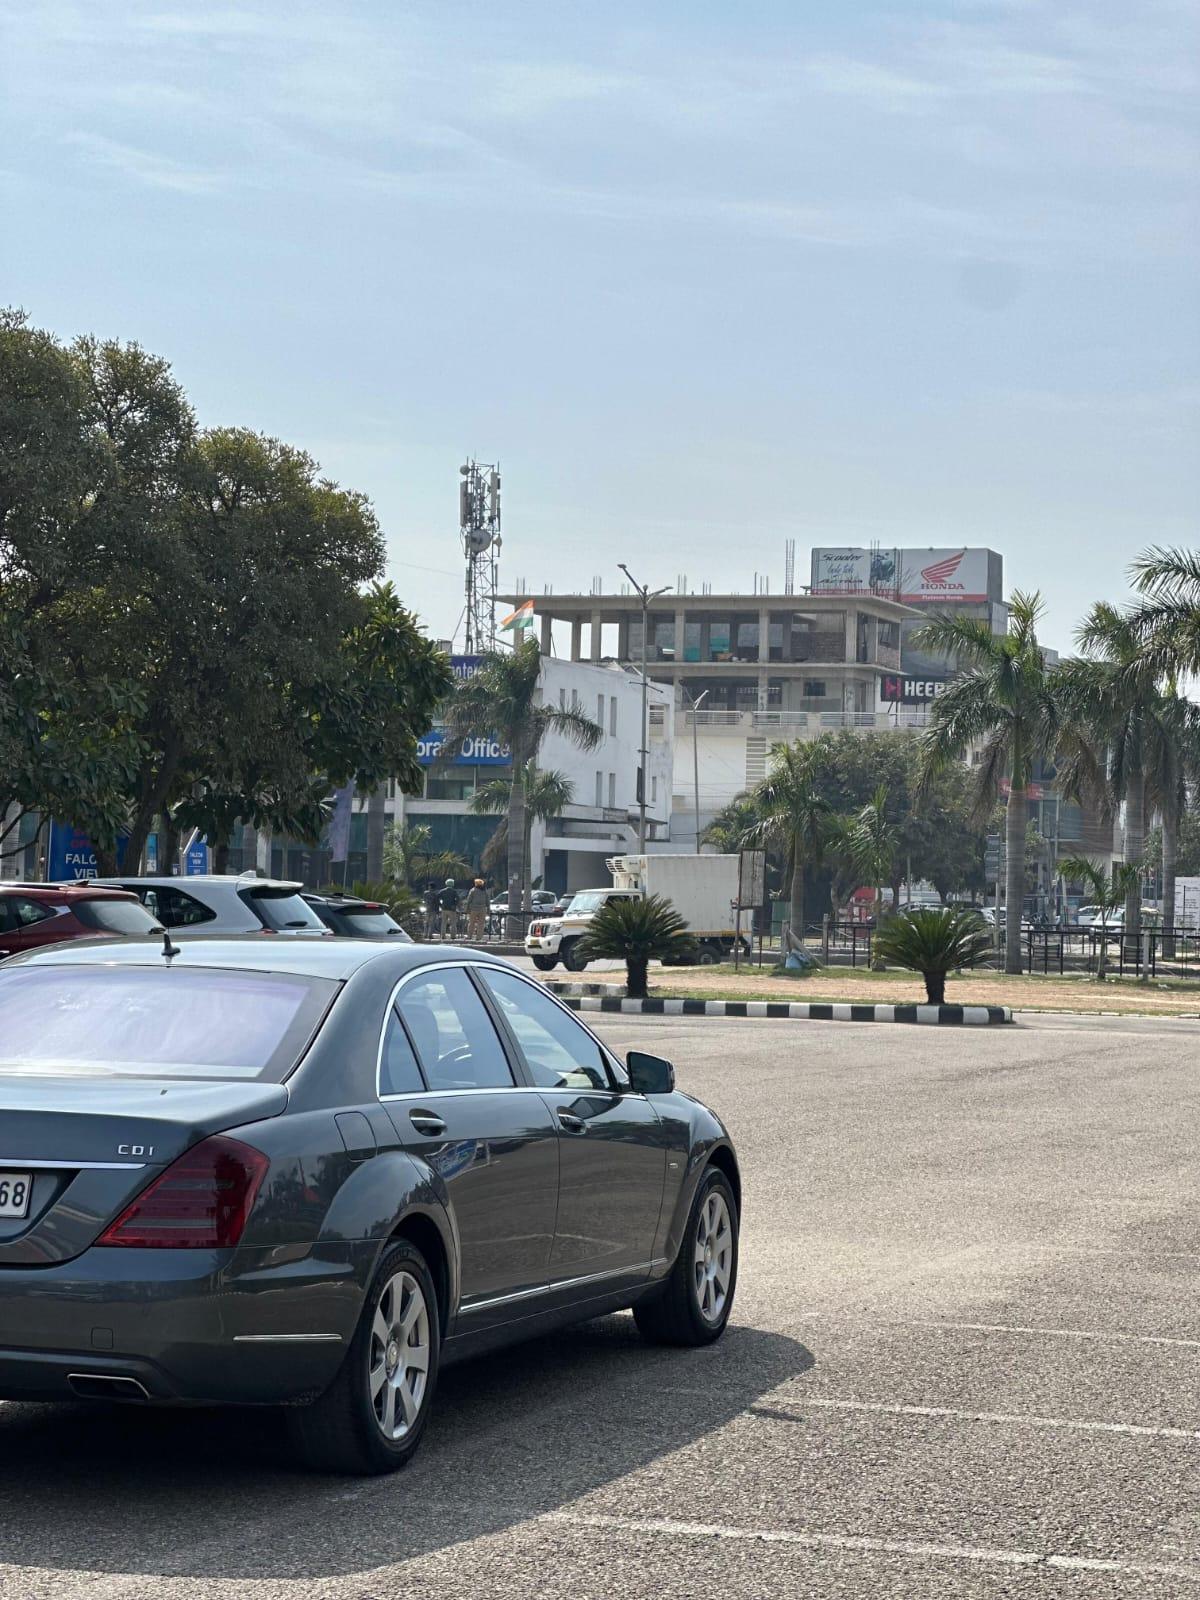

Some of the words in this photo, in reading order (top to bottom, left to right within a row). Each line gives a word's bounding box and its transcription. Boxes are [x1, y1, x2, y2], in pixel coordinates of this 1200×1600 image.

[416, 737, 447, 757] ora
[461, 737, 510, 757] Office
[117, 1144, 155, 1156] CDI
[0, 1181, 26, 1208] 68
